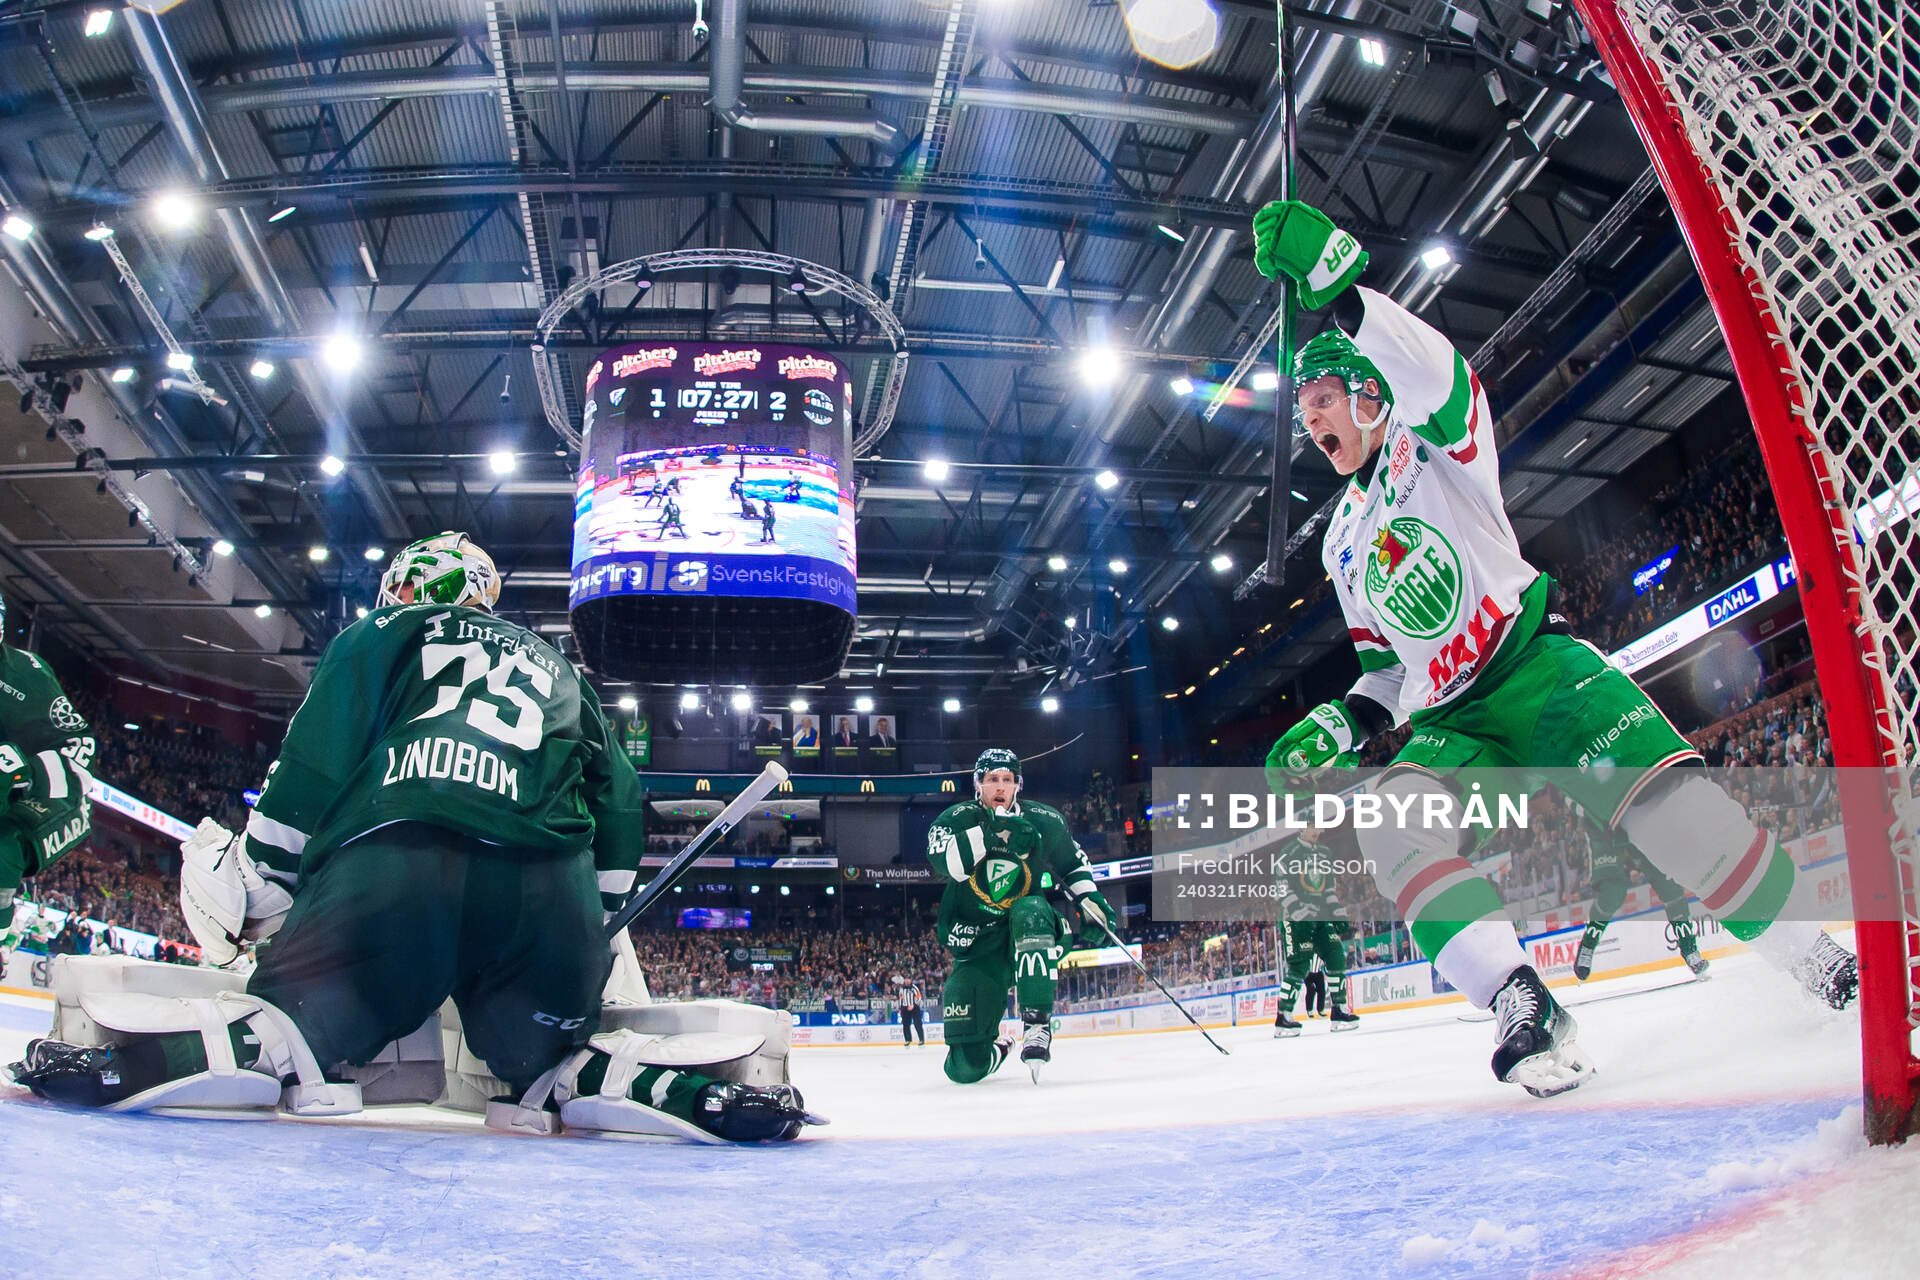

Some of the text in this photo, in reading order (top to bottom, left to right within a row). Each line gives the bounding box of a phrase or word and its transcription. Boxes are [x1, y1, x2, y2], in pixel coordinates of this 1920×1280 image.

[650, 388, 666, 407] 1
[682, 389, 754, 409] 07:27
[769, 392, 787, 410] 2
[1710, 587, 1754, 621] DAHL
[407, 641, 554, 751] 75
[382, 737, 519, 802] LINDBOM
[865, 868, 931, 879] The Wolfpack
[992, 863, 1005, 878] F
[1391, 985, 1416, 1000] frakt
[831, 1014, 866, 1025] PMAB
